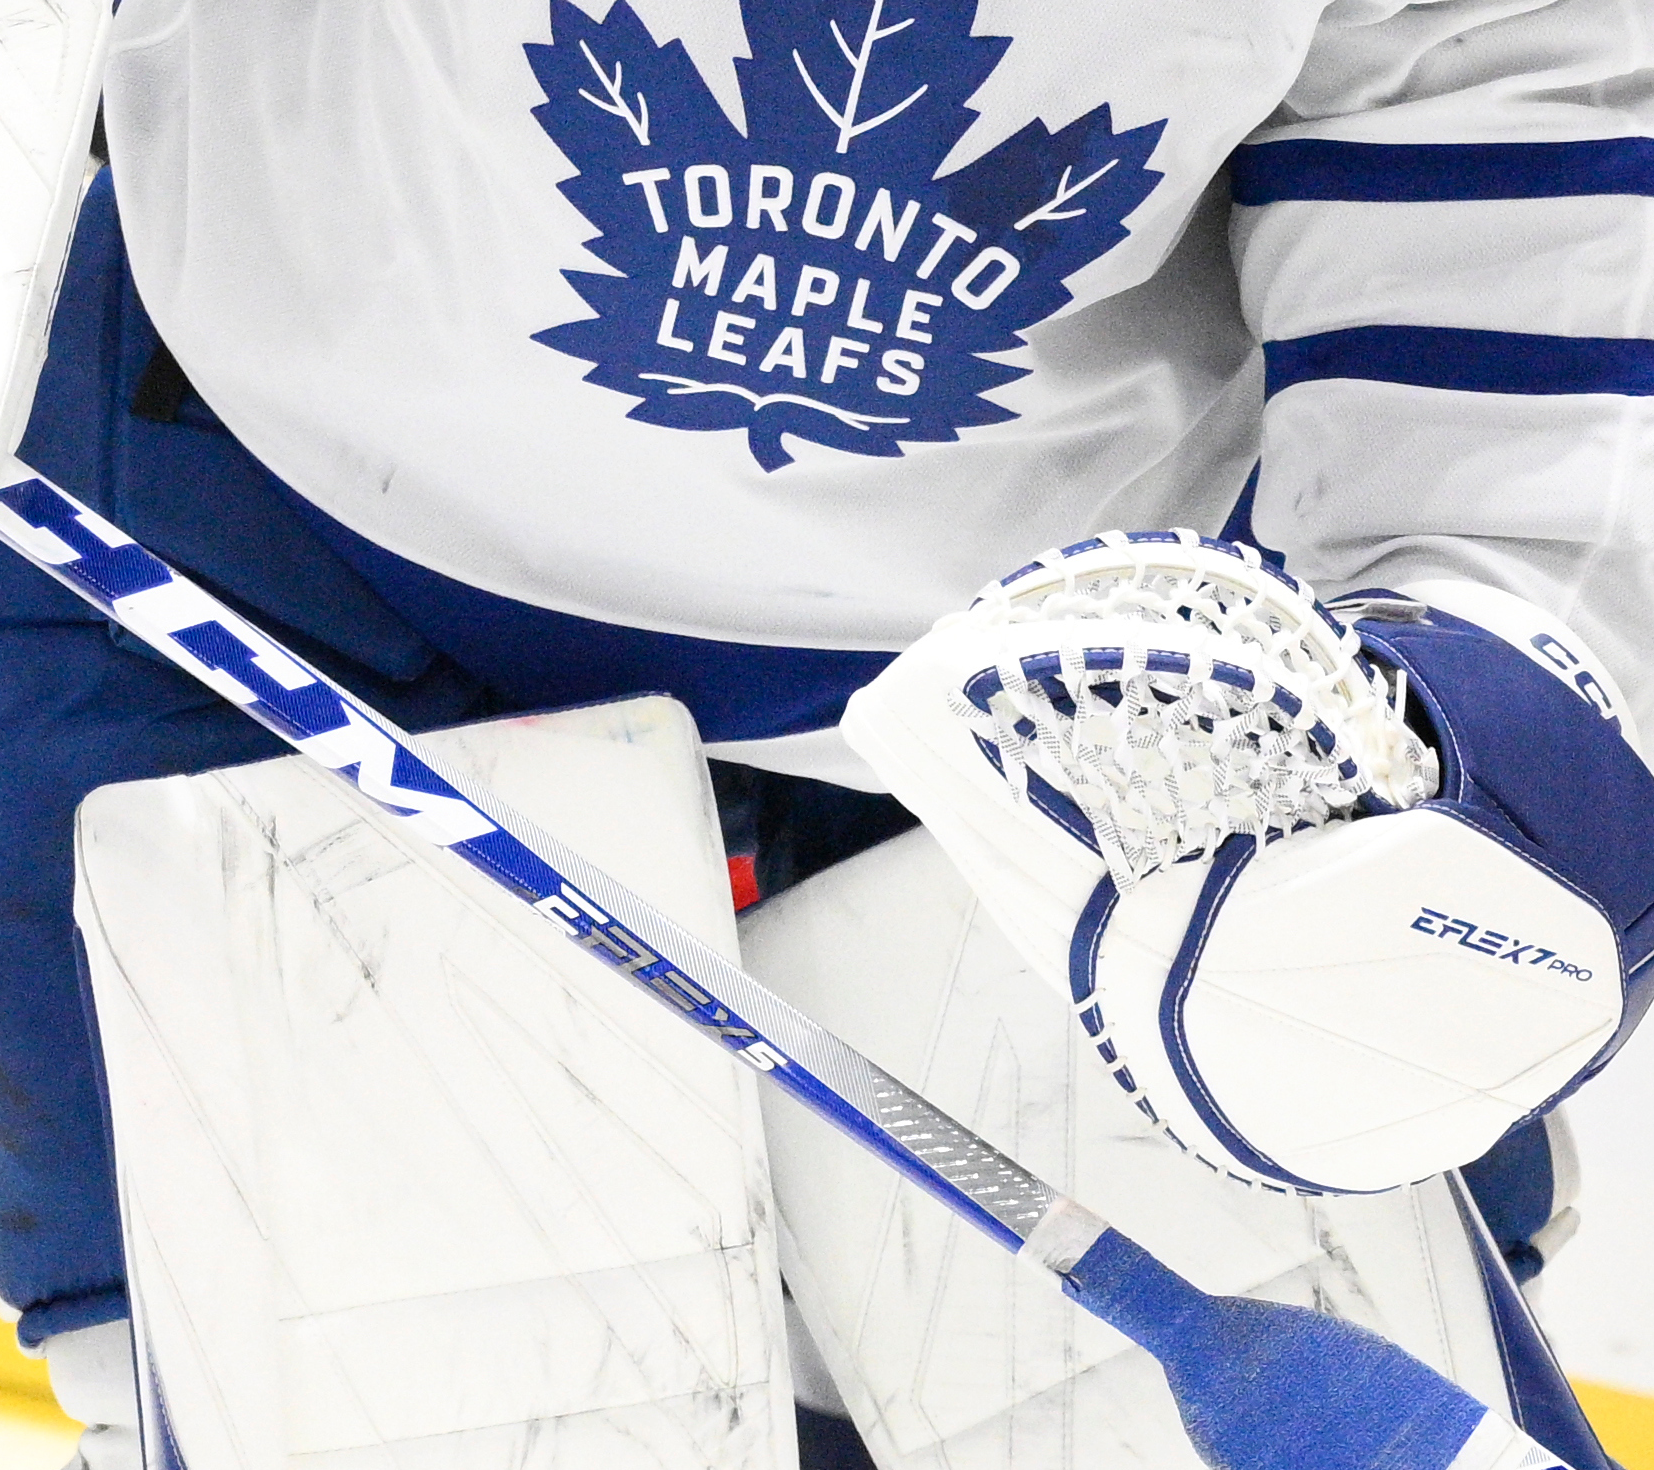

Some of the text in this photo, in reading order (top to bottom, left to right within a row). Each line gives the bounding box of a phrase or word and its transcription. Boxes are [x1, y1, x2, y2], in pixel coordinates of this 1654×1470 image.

[623, 164, 1020, 311] TORONTO
[672, 236, 943, 345] MAPLE
[656, 300, 926, 396] LEAFS
[1530, 633, 1621, 736] CC
